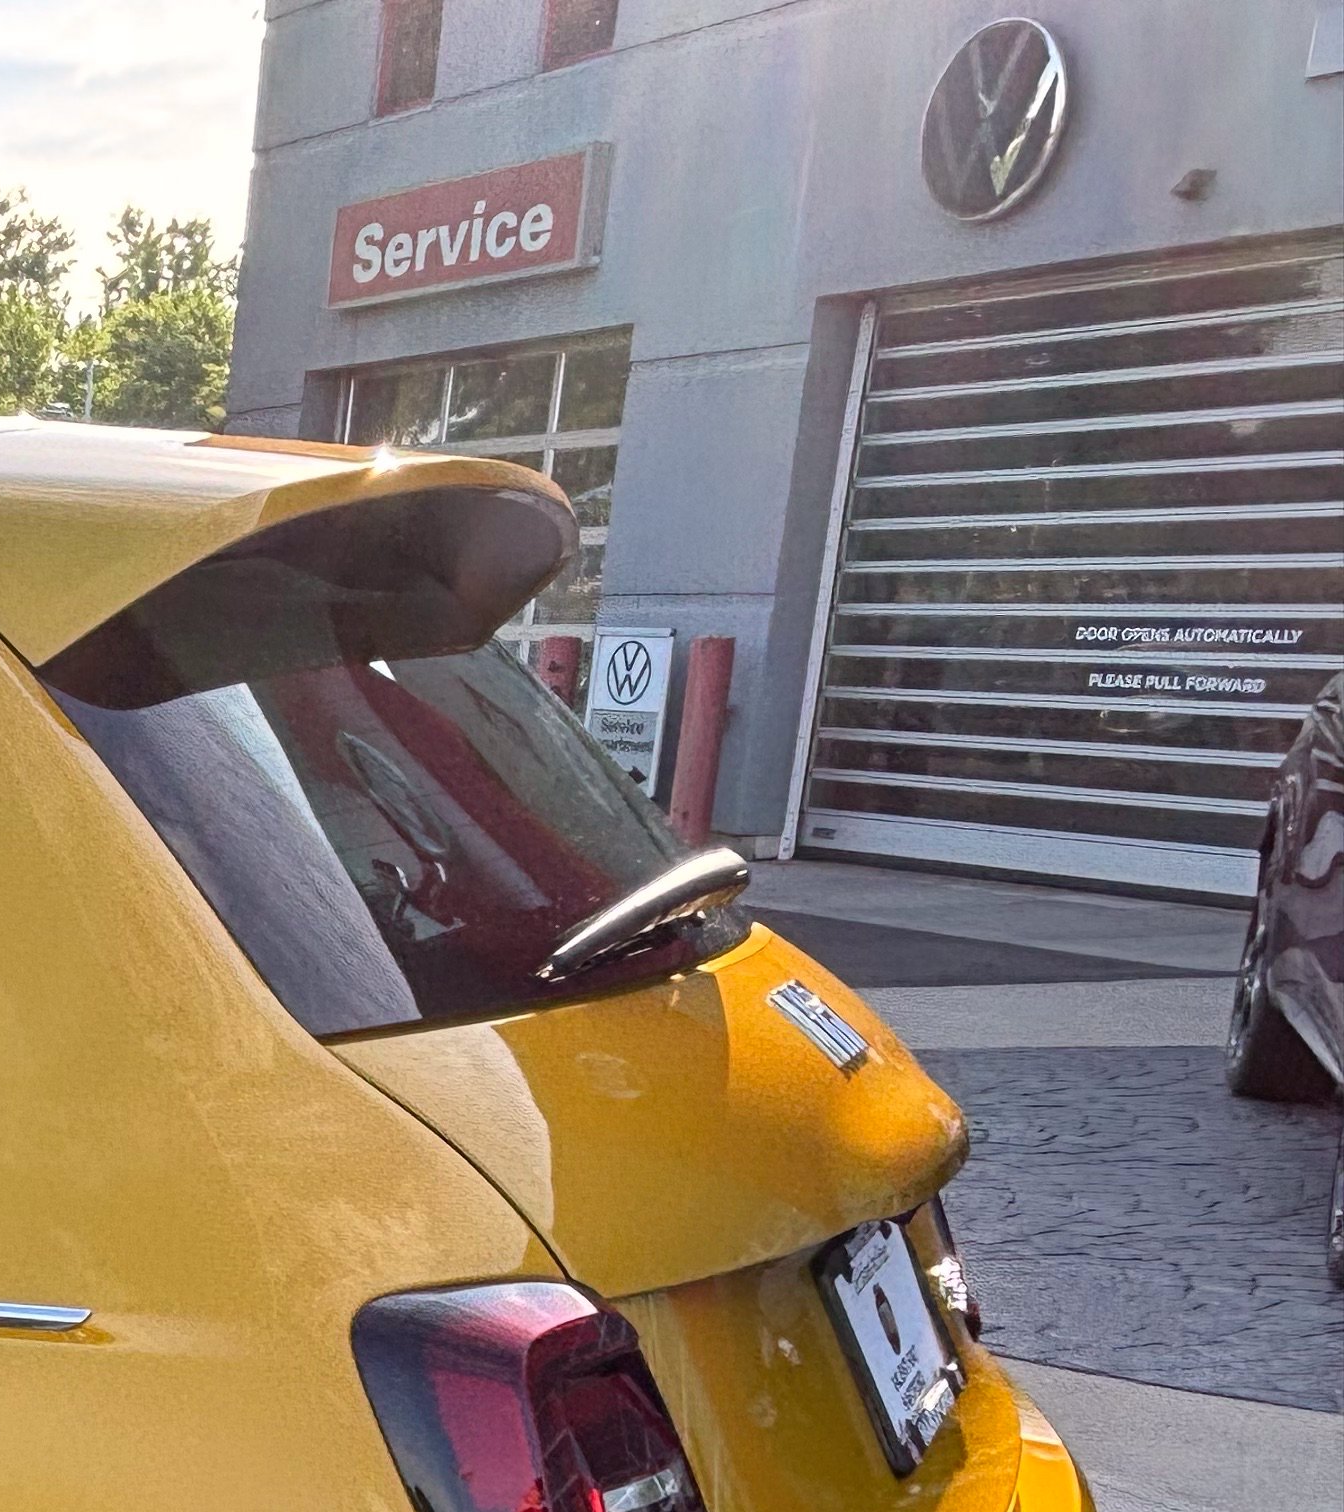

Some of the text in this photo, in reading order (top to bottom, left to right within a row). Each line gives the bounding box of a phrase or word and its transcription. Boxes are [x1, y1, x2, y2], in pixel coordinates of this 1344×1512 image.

[352, 200, 554, 284] Service
[1075, 626, 1303, 644] DOOR OPENS AUTOMATICALLY
[1088, 673, 1267, 694] PLEASE PULL FORWARD
